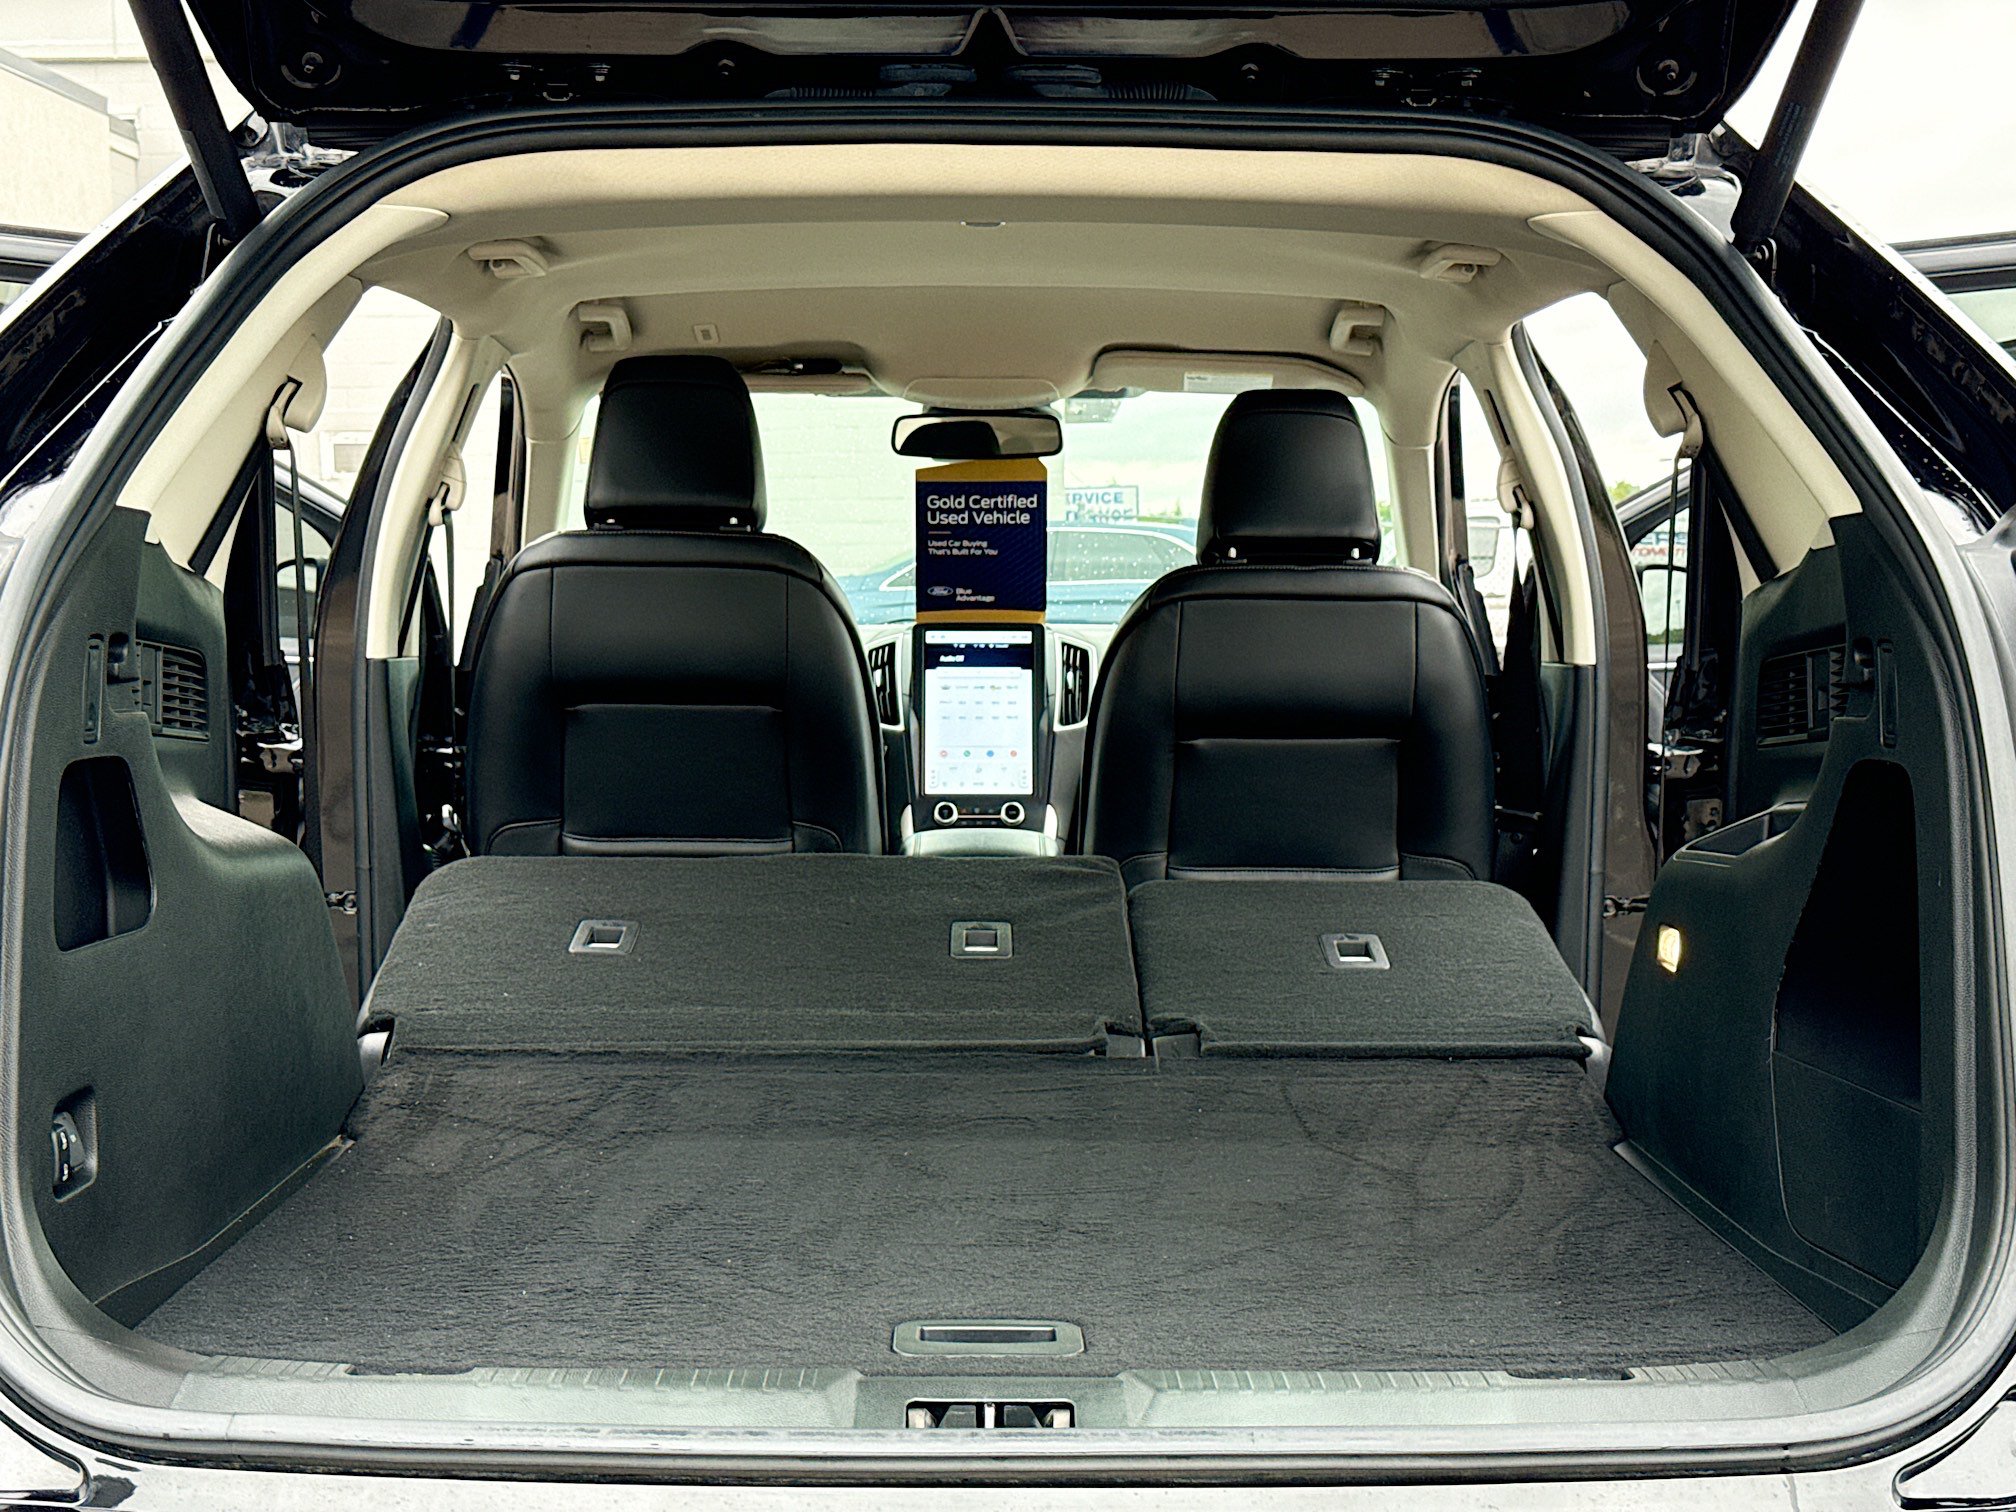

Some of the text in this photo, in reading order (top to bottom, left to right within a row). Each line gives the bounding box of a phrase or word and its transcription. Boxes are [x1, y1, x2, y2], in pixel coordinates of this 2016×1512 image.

[927, 494, 1037, 509] Gold Certified
[927, 510, 1031, 525] Used Vehicle
[962, 540, 988, 548] Buying
[952, 548, 969, 556] Built
[970, 548, 983, 556] For
[984, 548, 999, 556] You
[956, 587, 972, 595] Blue
